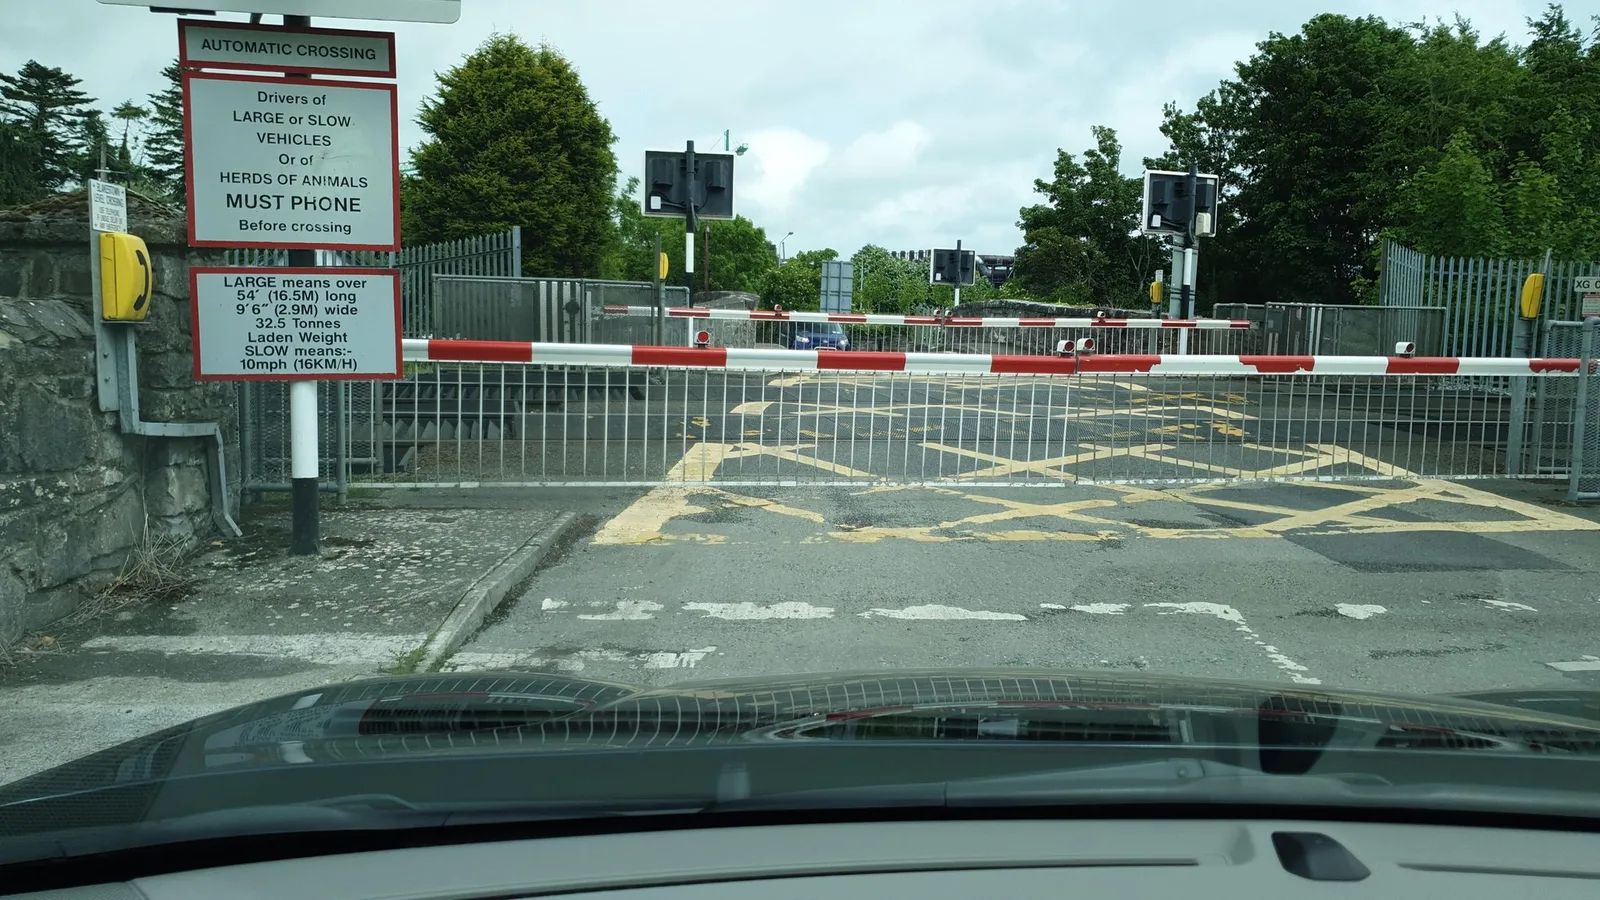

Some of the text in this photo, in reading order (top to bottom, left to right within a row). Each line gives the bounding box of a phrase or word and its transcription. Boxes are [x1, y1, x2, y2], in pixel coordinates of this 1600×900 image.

[201, 39, 376, 60] AUTOMATIC CROSSING
[257, 91, 327, 105] Drivers of
[233, 110, 351, 127] LARGE or SLOW
[257, 132, 331, 146] VEHICLES
[278, 153, 314, 166] Or of
[220, 171, 368, 188] HERDS OF ANIMALS
[226, 193, 361, 212] MUST PHONE
[239, 219, 352, 235] Before crossing
[224, 276, 367, 289] LARGE means over
[1576, 280, 1590, 289] XG
[268, 290, 319, 303] (16.5M)
[325, 290, 357, 304] long
[274, 304, 318, 317] (2.9M)
[324, 304, 358, 315] wide
[255, 318, 341, 329] 32.5 Tonnes
[248, 332, 348, 345] Laden Weight
[245, 345, 289, 357] SLOW
[240, 358, 357, 372] 10mph (16KM/H)
